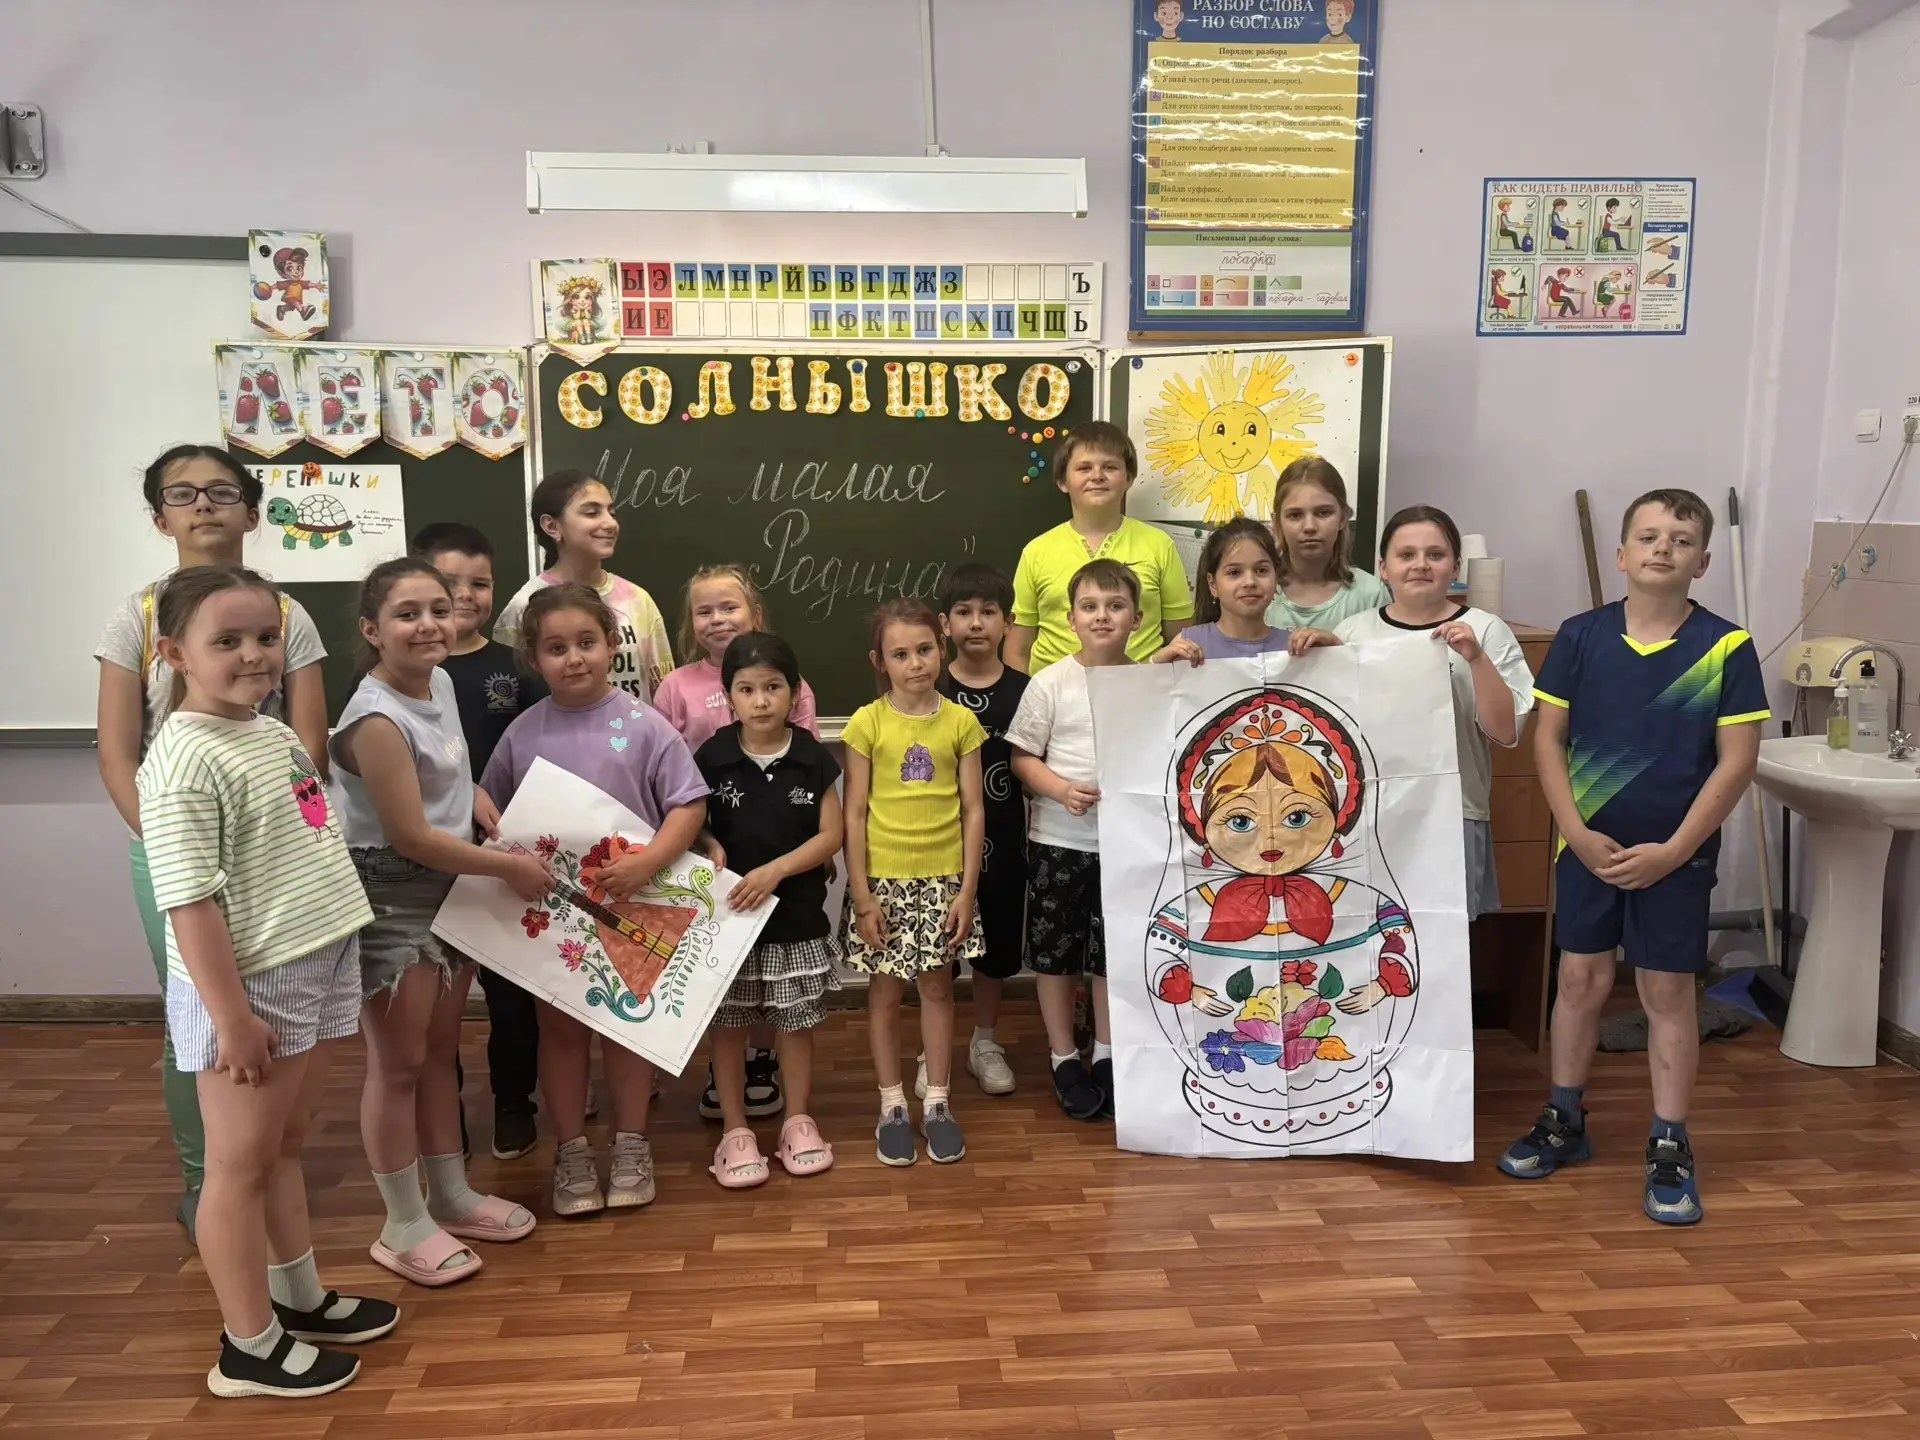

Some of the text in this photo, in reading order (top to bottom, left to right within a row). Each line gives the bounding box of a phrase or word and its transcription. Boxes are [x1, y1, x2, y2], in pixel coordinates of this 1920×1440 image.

[1192, 0, 1315, 12] РАЗБОР СЛОВА
[1230, 15, 1304, 29] СОСТАВУ
[1219, 48, 1288, 56] Порядок разбора
[1161, 102, 1177, 110] Для
[1161, 159, 1186, 167] Найди
[1161, 170, 1177, 178] Для
[1198, 170, 1228, 178] подбери
[1160, 185, 1186, 193] Найди
[1494, 183, 1642, 194] КАК СИДЕТЬ ПРАВИЛЬНО
[1258, 212, 1306, 220] орфограммы
[1196, 234, 1246, 242] Письменный
[558, 356, 1071, 429] СОЛНЫШКО
[231, 363, 521, 438] ЛЕТО
[1908, 396, 1917, 404] 220
[728, 461, 946, 504] малая
